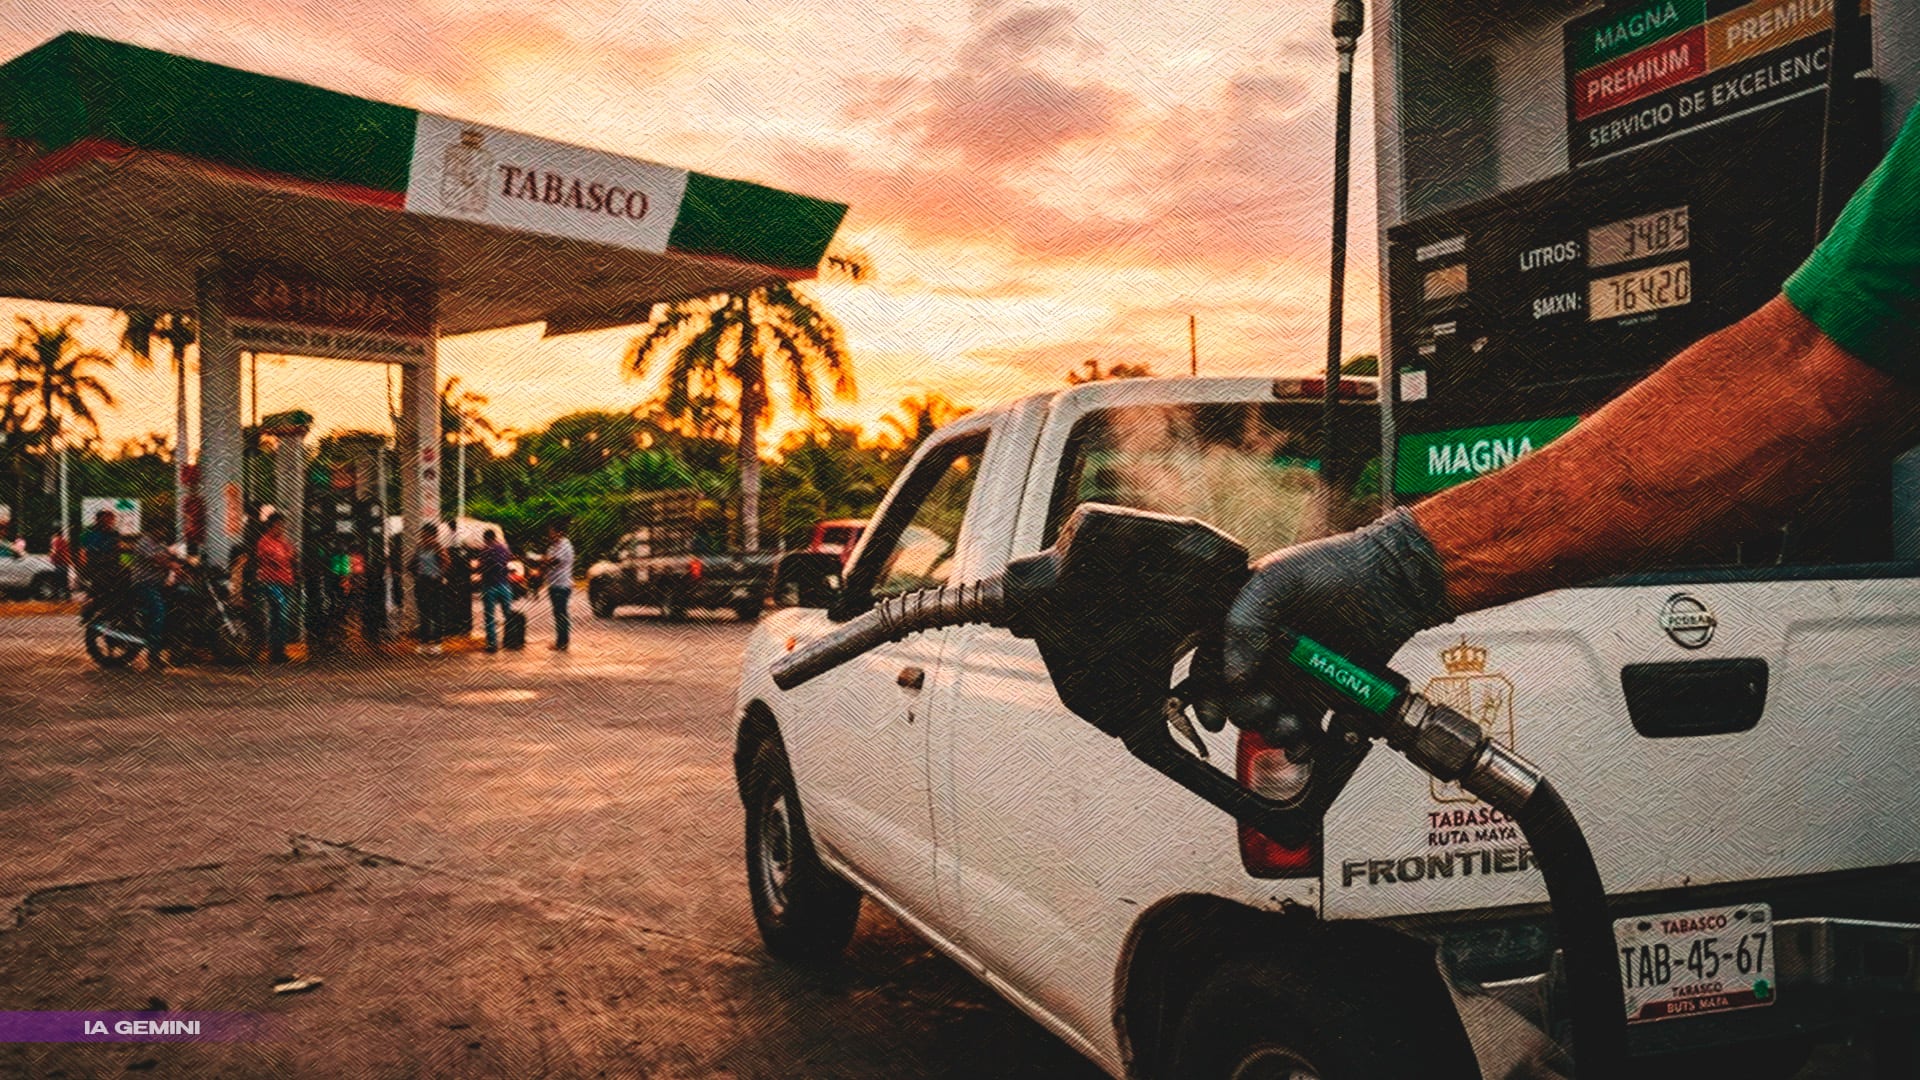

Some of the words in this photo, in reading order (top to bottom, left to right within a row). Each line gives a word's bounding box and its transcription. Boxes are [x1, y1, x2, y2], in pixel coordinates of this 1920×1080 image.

[1594, 1, 1679, 54] MAGNA
[1726, 0, 1834, 50] PREMIU
[1586, 44, 1690, 103] PREMIUM
[1589, 103, 1674, 149] SERVICIO
[1679, 90, 1706, 118] DE
[1711, 46, 1832, 107] EXCELENC
[498, 164, 649, 220] TABASCO
[1519, 240, 1582, 272] LITROS:
[1428, 436, 1533, 475] MAGNA
[1308, 653, 1371, 699] MAGNA
[1428, 830, 1470, 846] RUTA
[1475, 826, 1517, 842] MAYA
[1661, 915, 1727, 934] TABASCO
[1621, 932, 1767, 990] TAB-45-67
